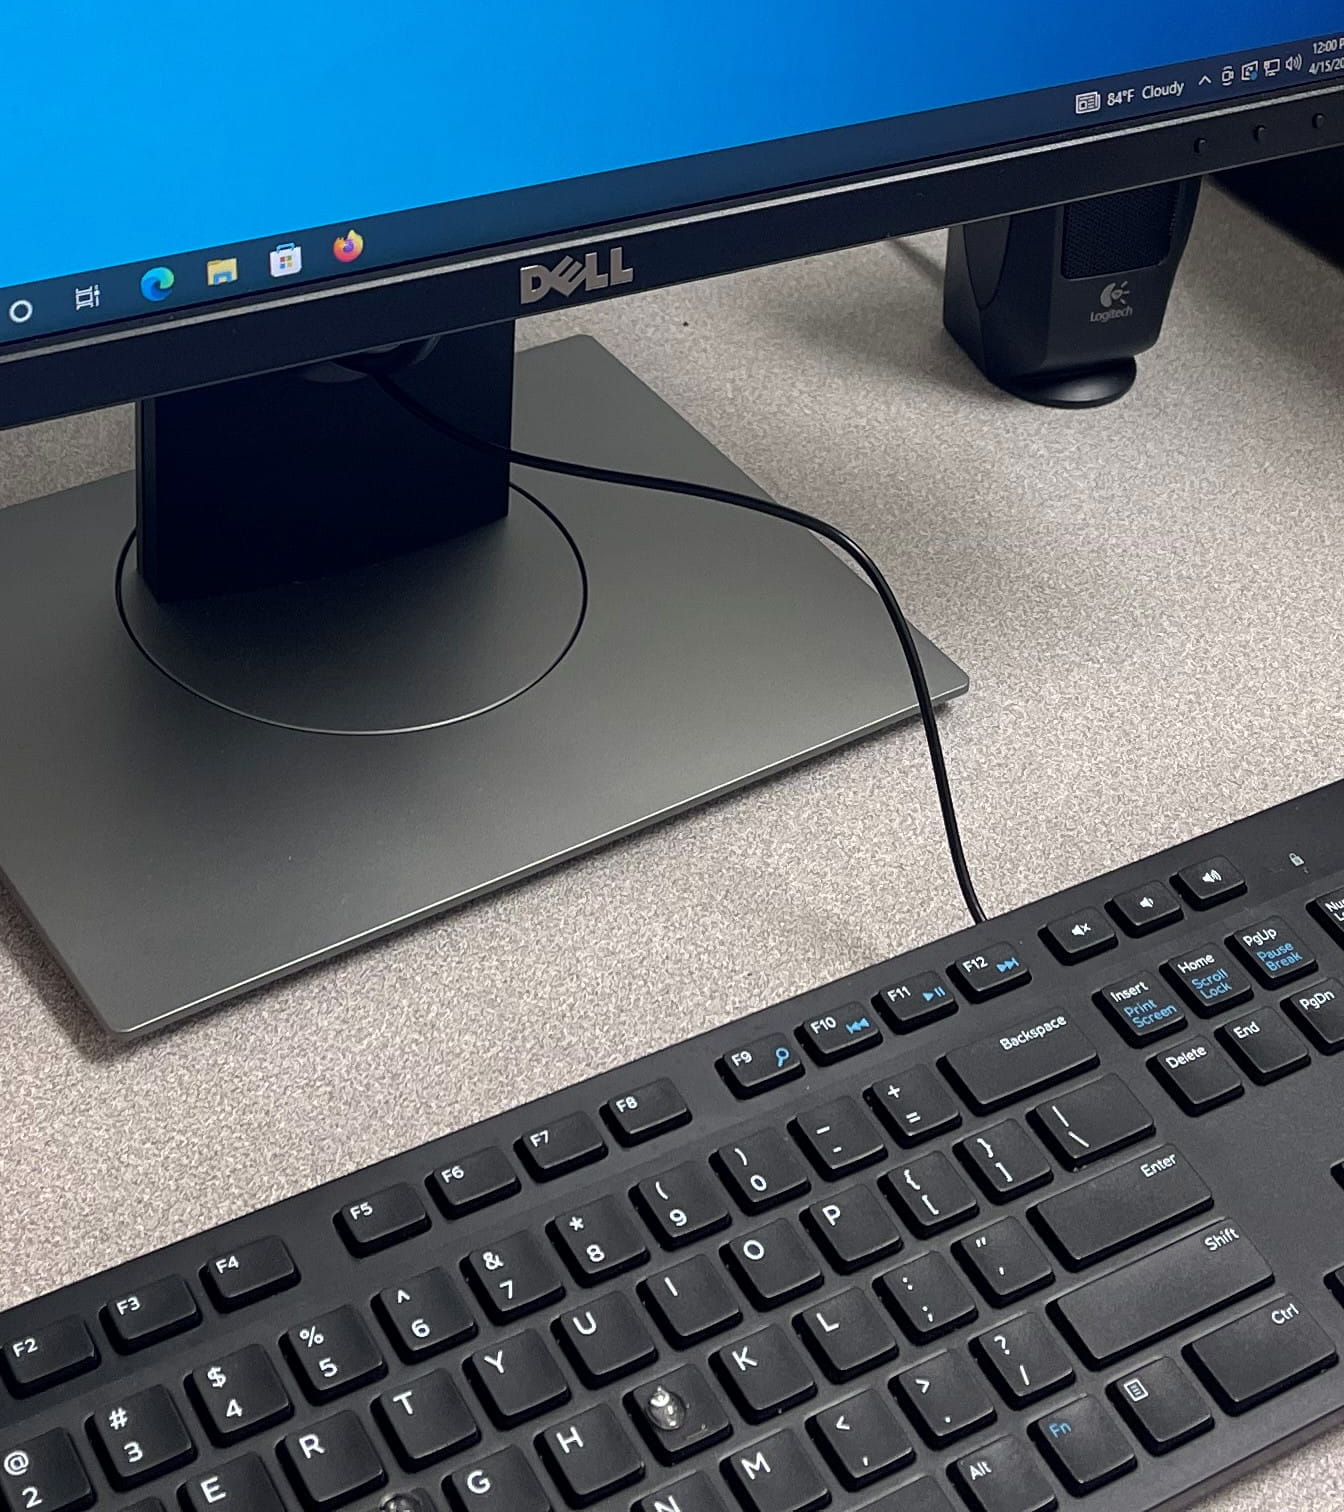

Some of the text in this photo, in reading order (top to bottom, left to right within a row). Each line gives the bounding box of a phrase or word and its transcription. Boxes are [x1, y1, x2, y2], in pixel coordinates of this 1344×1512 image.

[1312, 38, 1338, 55] 12:00
[1141, 79, 1185, 100] Cloudy
[519, 246, 634, 305] DELL
[1089, 305, 1133, 323] Logitech
[1243, 927, 1278, 949] PgUp
[1256, 942, 1294, 963] Pause
[1265, 952, 1303, 973] Break
[963, 956, 989, 974] F12
[1178, 953, 1216, 975] Home
[1191, 968, 1229, 991] Scroll
[887, 986, 912, 1003] F11
[1110, 981, 1149, 1003] Insert
[1200, 981, 1233, 1001] Lock
[1299, 990, 1336, 1012] PgDn
[1124, 999, 1158, 1019] Print
[1132, 1003, 1178, 1030] Screen
[811, 1017, 837, 1035] F10
[1000, 1014, 1068, 1052] Backspace
[1233, 1021, 1261, 1041] End
[731, 1051, 754, 1067] F9
[1166, 1045, 1207, 1070] Delete
[616, 1096, 639, 1113] F8
[530, 1130, 551, 1148] F7
[442, 1166, 465, 1184] F6
[1141, 1153, 1177, 1179] Enter
[350, 1202, 374, 1221] F5
[670, 1209, 688, 1228] 9
[823, 1205, 842, 1226] P
[1204, 1227, 1240, 1252] Shift
[587, 1245, 606, 1263] 8
[216, 1255, 241, 1275] F4
[499, 1280, 515, 1300] 7
[117, 1297, 142, 1317] F3
[1271, 1303, 1300, 1325] Ctrl
[411, 1319, 431, 1339] 6
[572, 1312, 598, 1336] U
[817, 1312, 841, 1332] L
[12, 1338, 39, 1358] F2
[319, 1357, 339, 1378] 5
[484, 1350, 506, 1375] Y
[732, 1347, 758, 1371] K
[225, 1399, 244, 1419] 4
[394, 1391, 415, 1416] T
[556, 1426, 585, 1454] H
[1049, 1422, 1073, 1439] Fn
[123, 1442, 144, 1463] 3
[298, 1434, 327, 1460] R
[741, 1453, 772, 1480] M
[969, 1461, 993, 1480] Alt
[201, 1475, 227, 1505] E
[467, 1470, 492, 1495] G
[21, 1487, 43, 1510] 2
